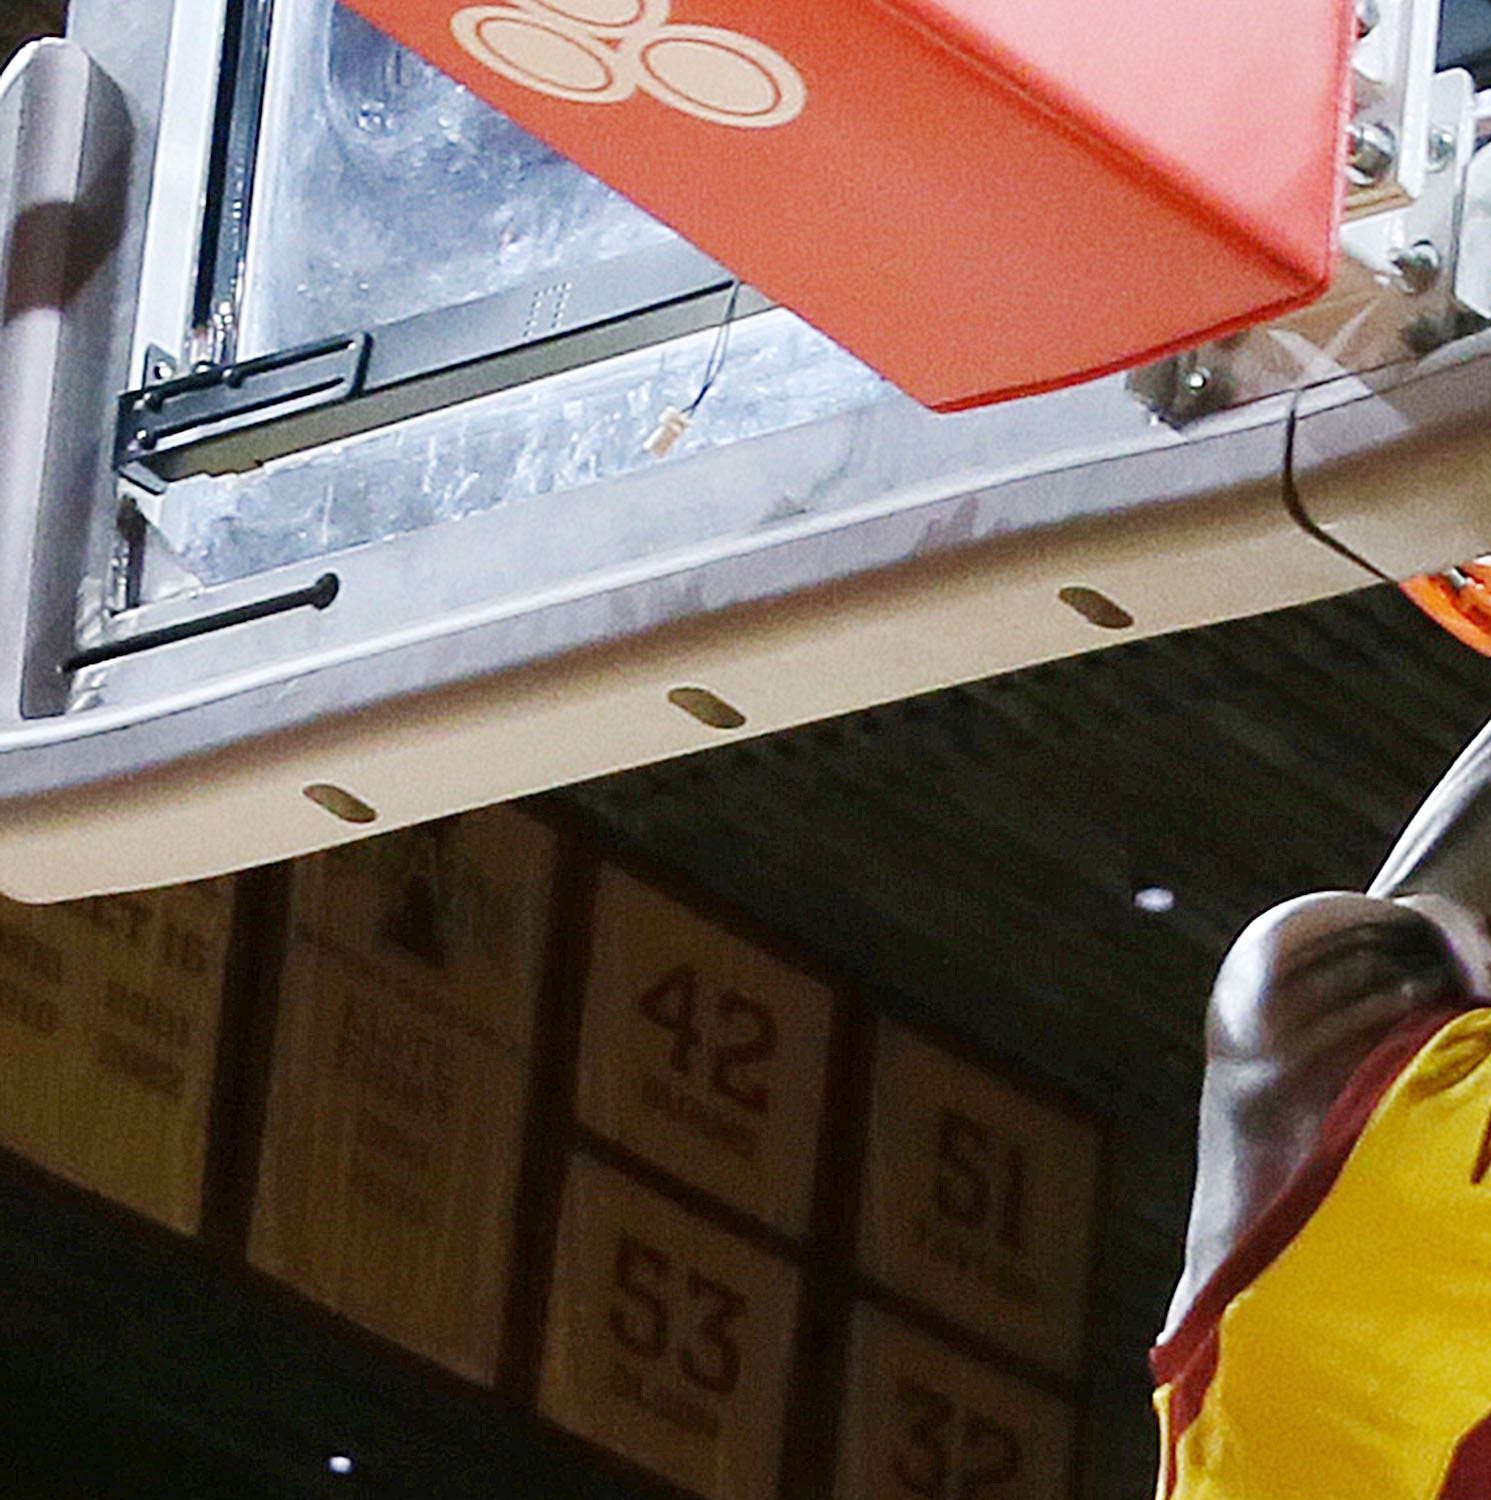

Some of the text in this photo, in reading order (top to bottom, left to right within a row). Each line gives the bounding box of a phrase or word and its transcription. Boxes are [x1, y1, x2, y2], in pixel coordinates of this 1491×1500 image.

[637, 963, 778, 1115] 42
[937, 1107, 1024, 1250] 51
[608, 1227, 747, 1393] 53
